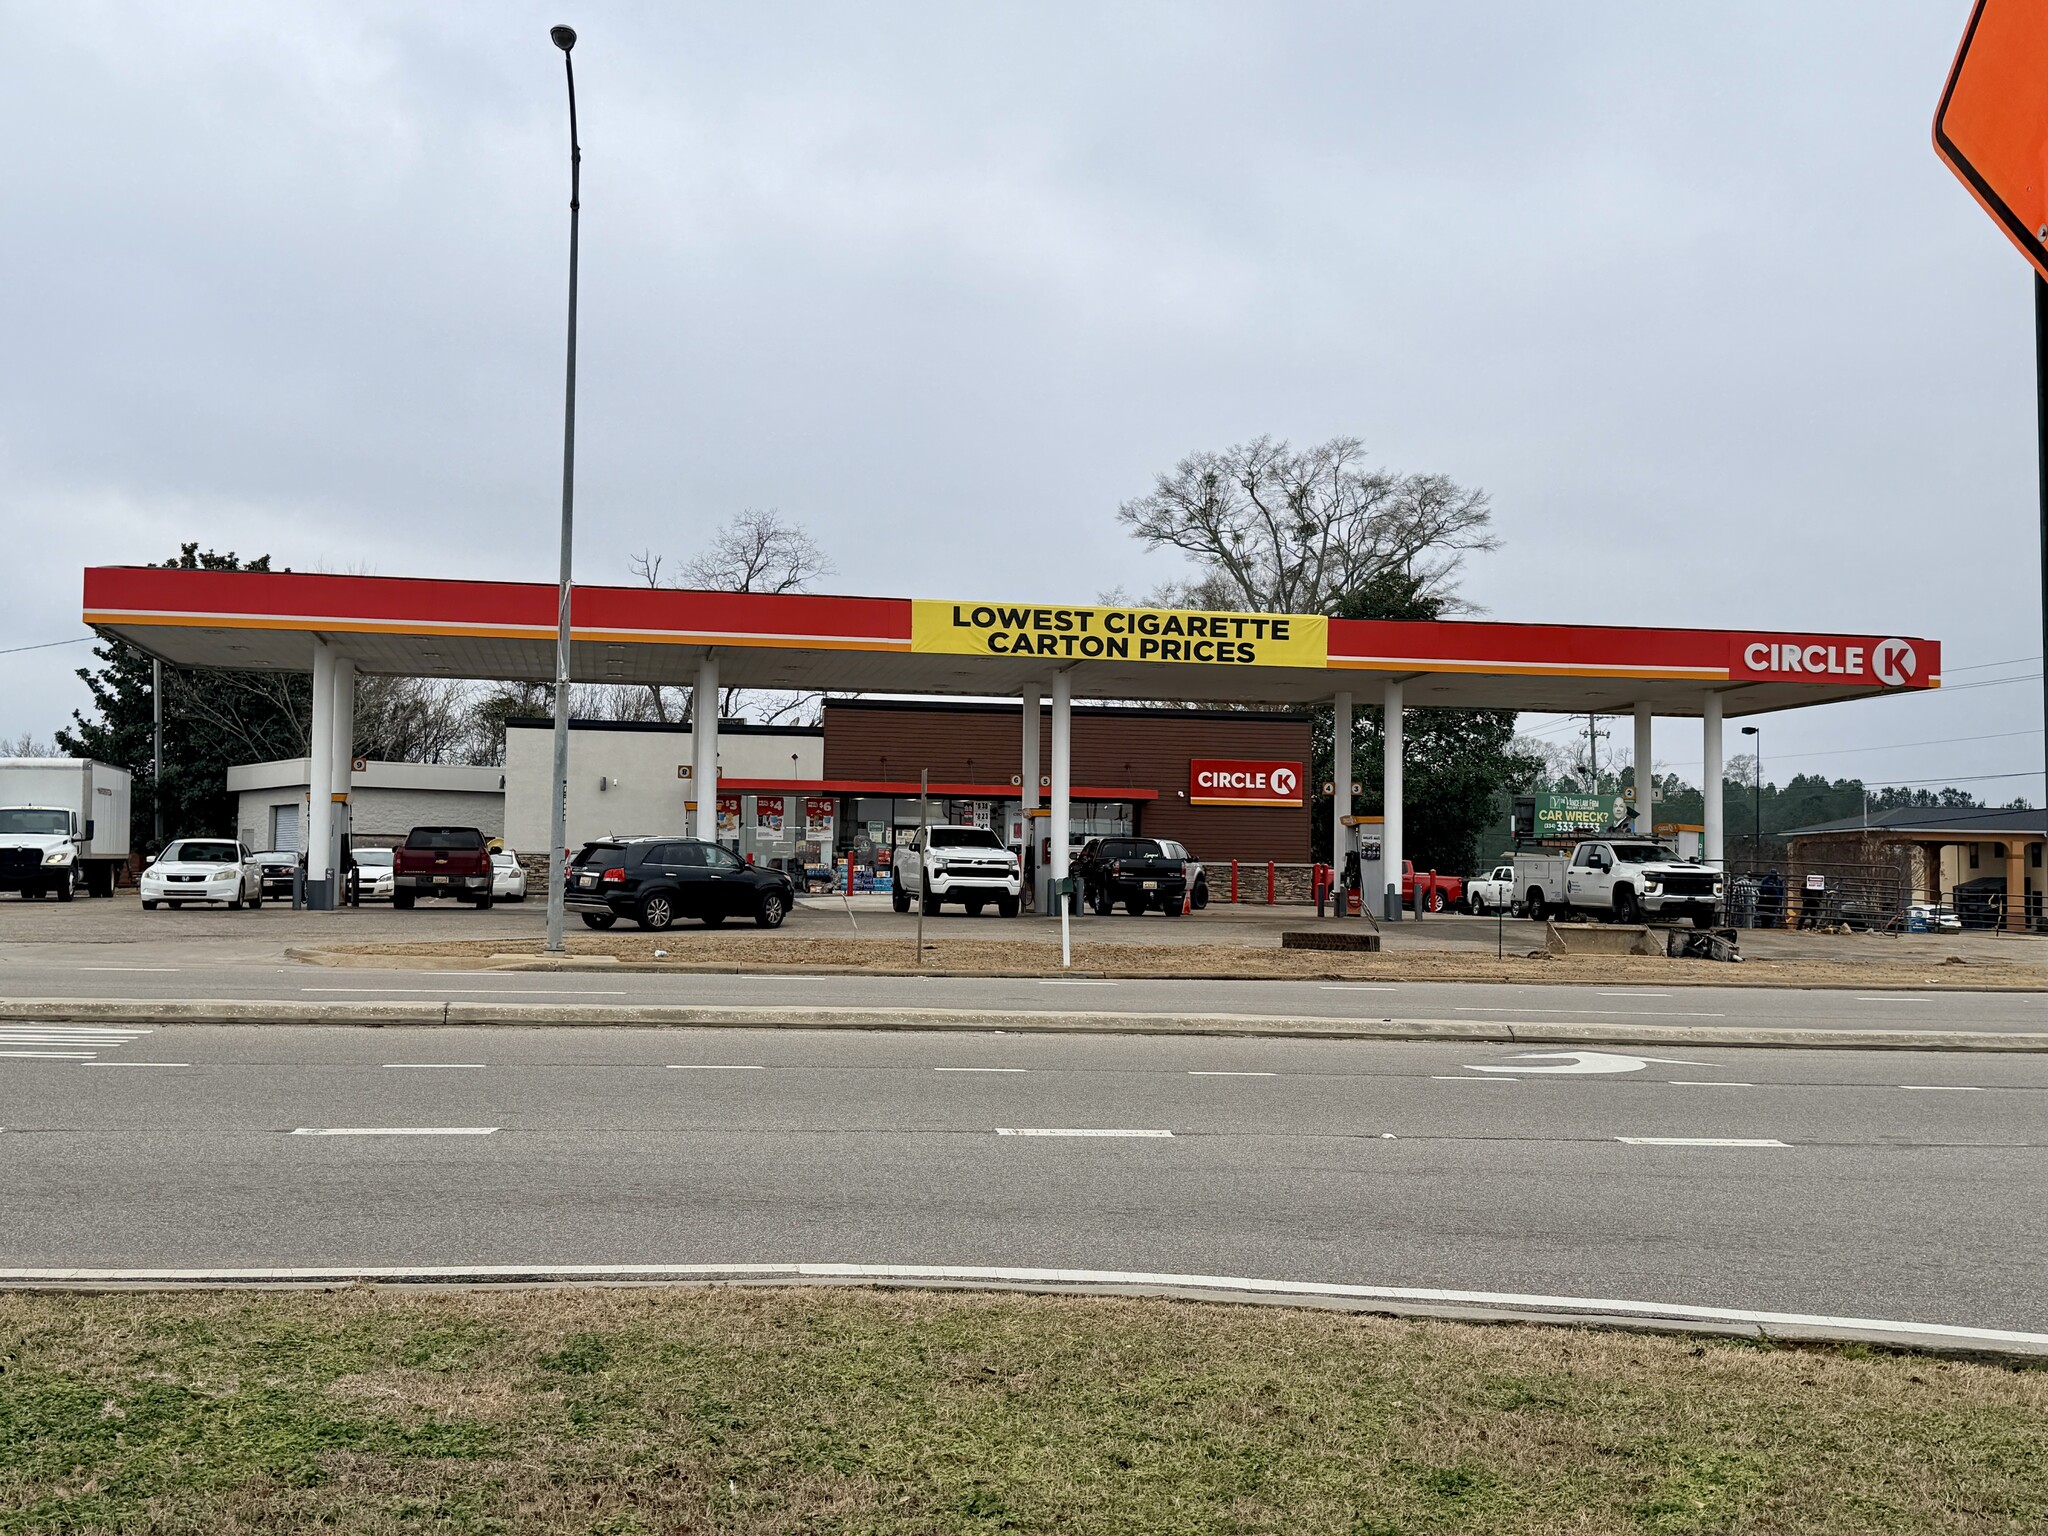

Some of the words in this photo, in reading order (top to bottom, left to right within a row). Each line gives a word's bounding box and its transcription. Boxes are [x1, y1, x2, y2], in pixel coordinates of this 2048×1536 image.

[953, 605, 1094, 632] LOWEST
[1104, 611, 1290, 640] CIGARETTE
[987, 632, 1128, 658] CARTON
[1140, 638, 1255, 663] PRICES
[1744, 642, 1864, 674] CIRCLE
[1882, 645, 1914, 685] K
[1197, 771, 1266, 789] CIRCLE
[1275, 771, 1296, 794] K
[1325, 784, 1332, 792] 4
[725, 799, 738, 810] $3
[769, 800, 783, 811] $4
[819, 801, 832, 812] $6
[1538, 809, 1563, 821] CAR
[1565, 810, 1609, 823] WRECK?
